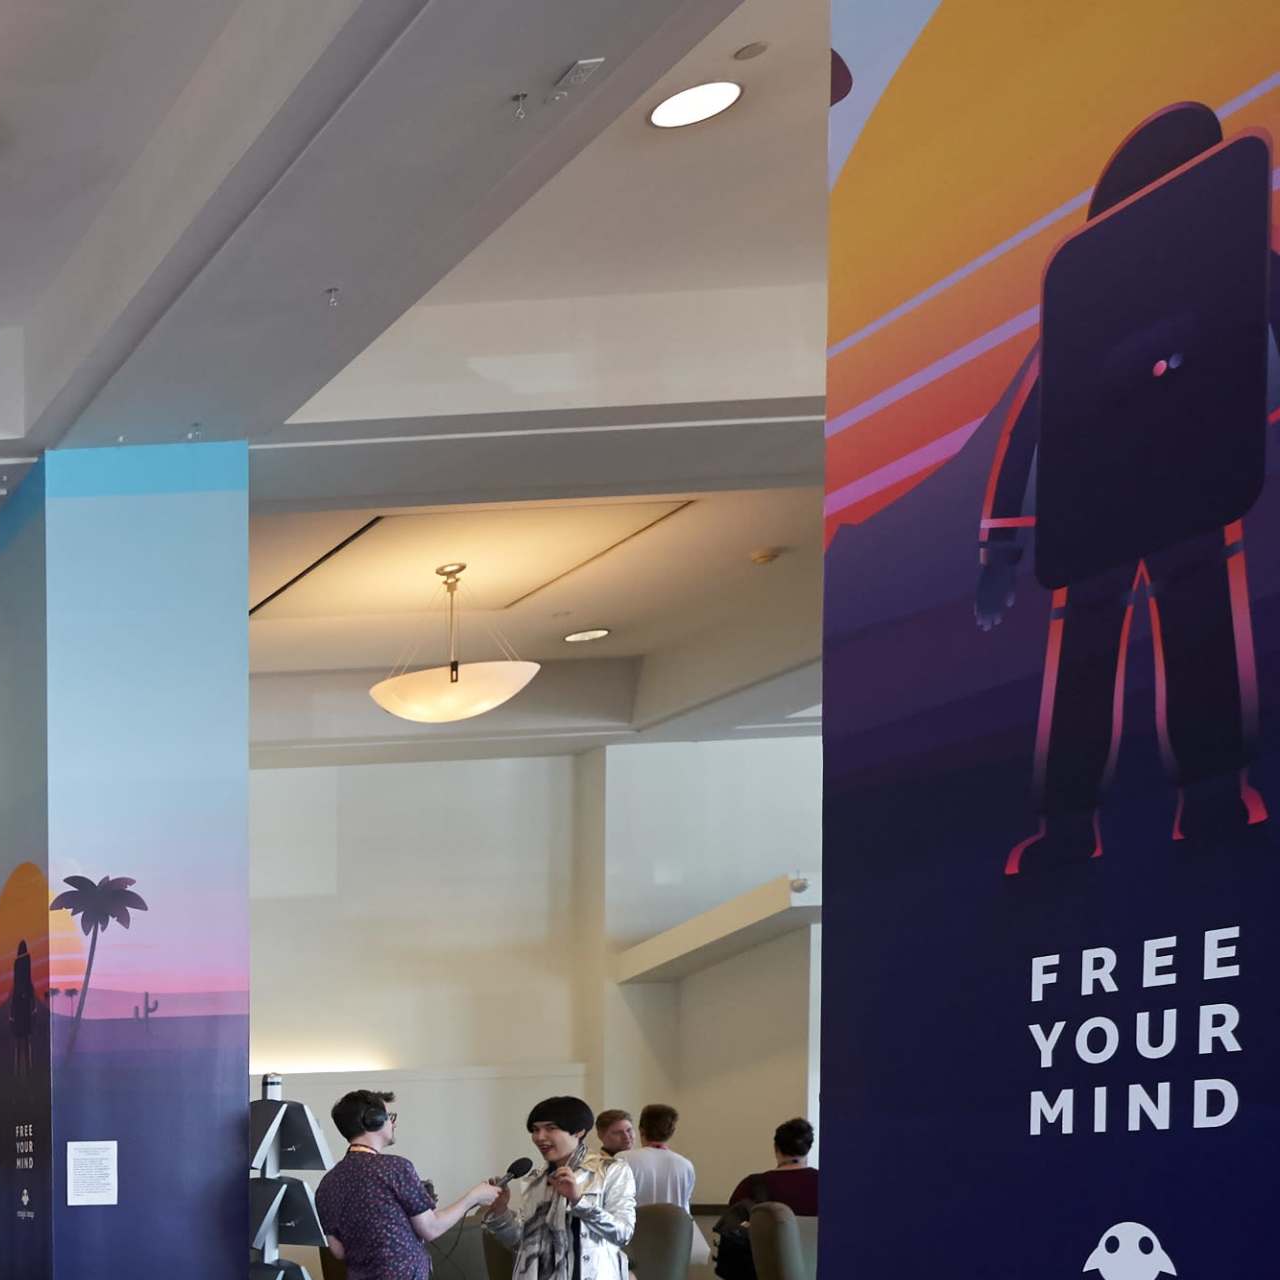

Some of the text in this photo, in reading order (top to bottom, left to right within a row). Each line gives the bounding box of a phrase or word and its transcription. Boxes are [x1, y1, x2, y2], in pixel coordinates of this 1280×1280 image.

[1031, 925, 1240, 1002] FREE
[1028, 1003, 1242, 1068] YOUR
[1029, 1078, 1239, 1136] MIND
[15, 1124, 33, 1137] FREE
[16, 1140, 34, 1153] YOUR
[16, 1157, 34, 1169] MIND
